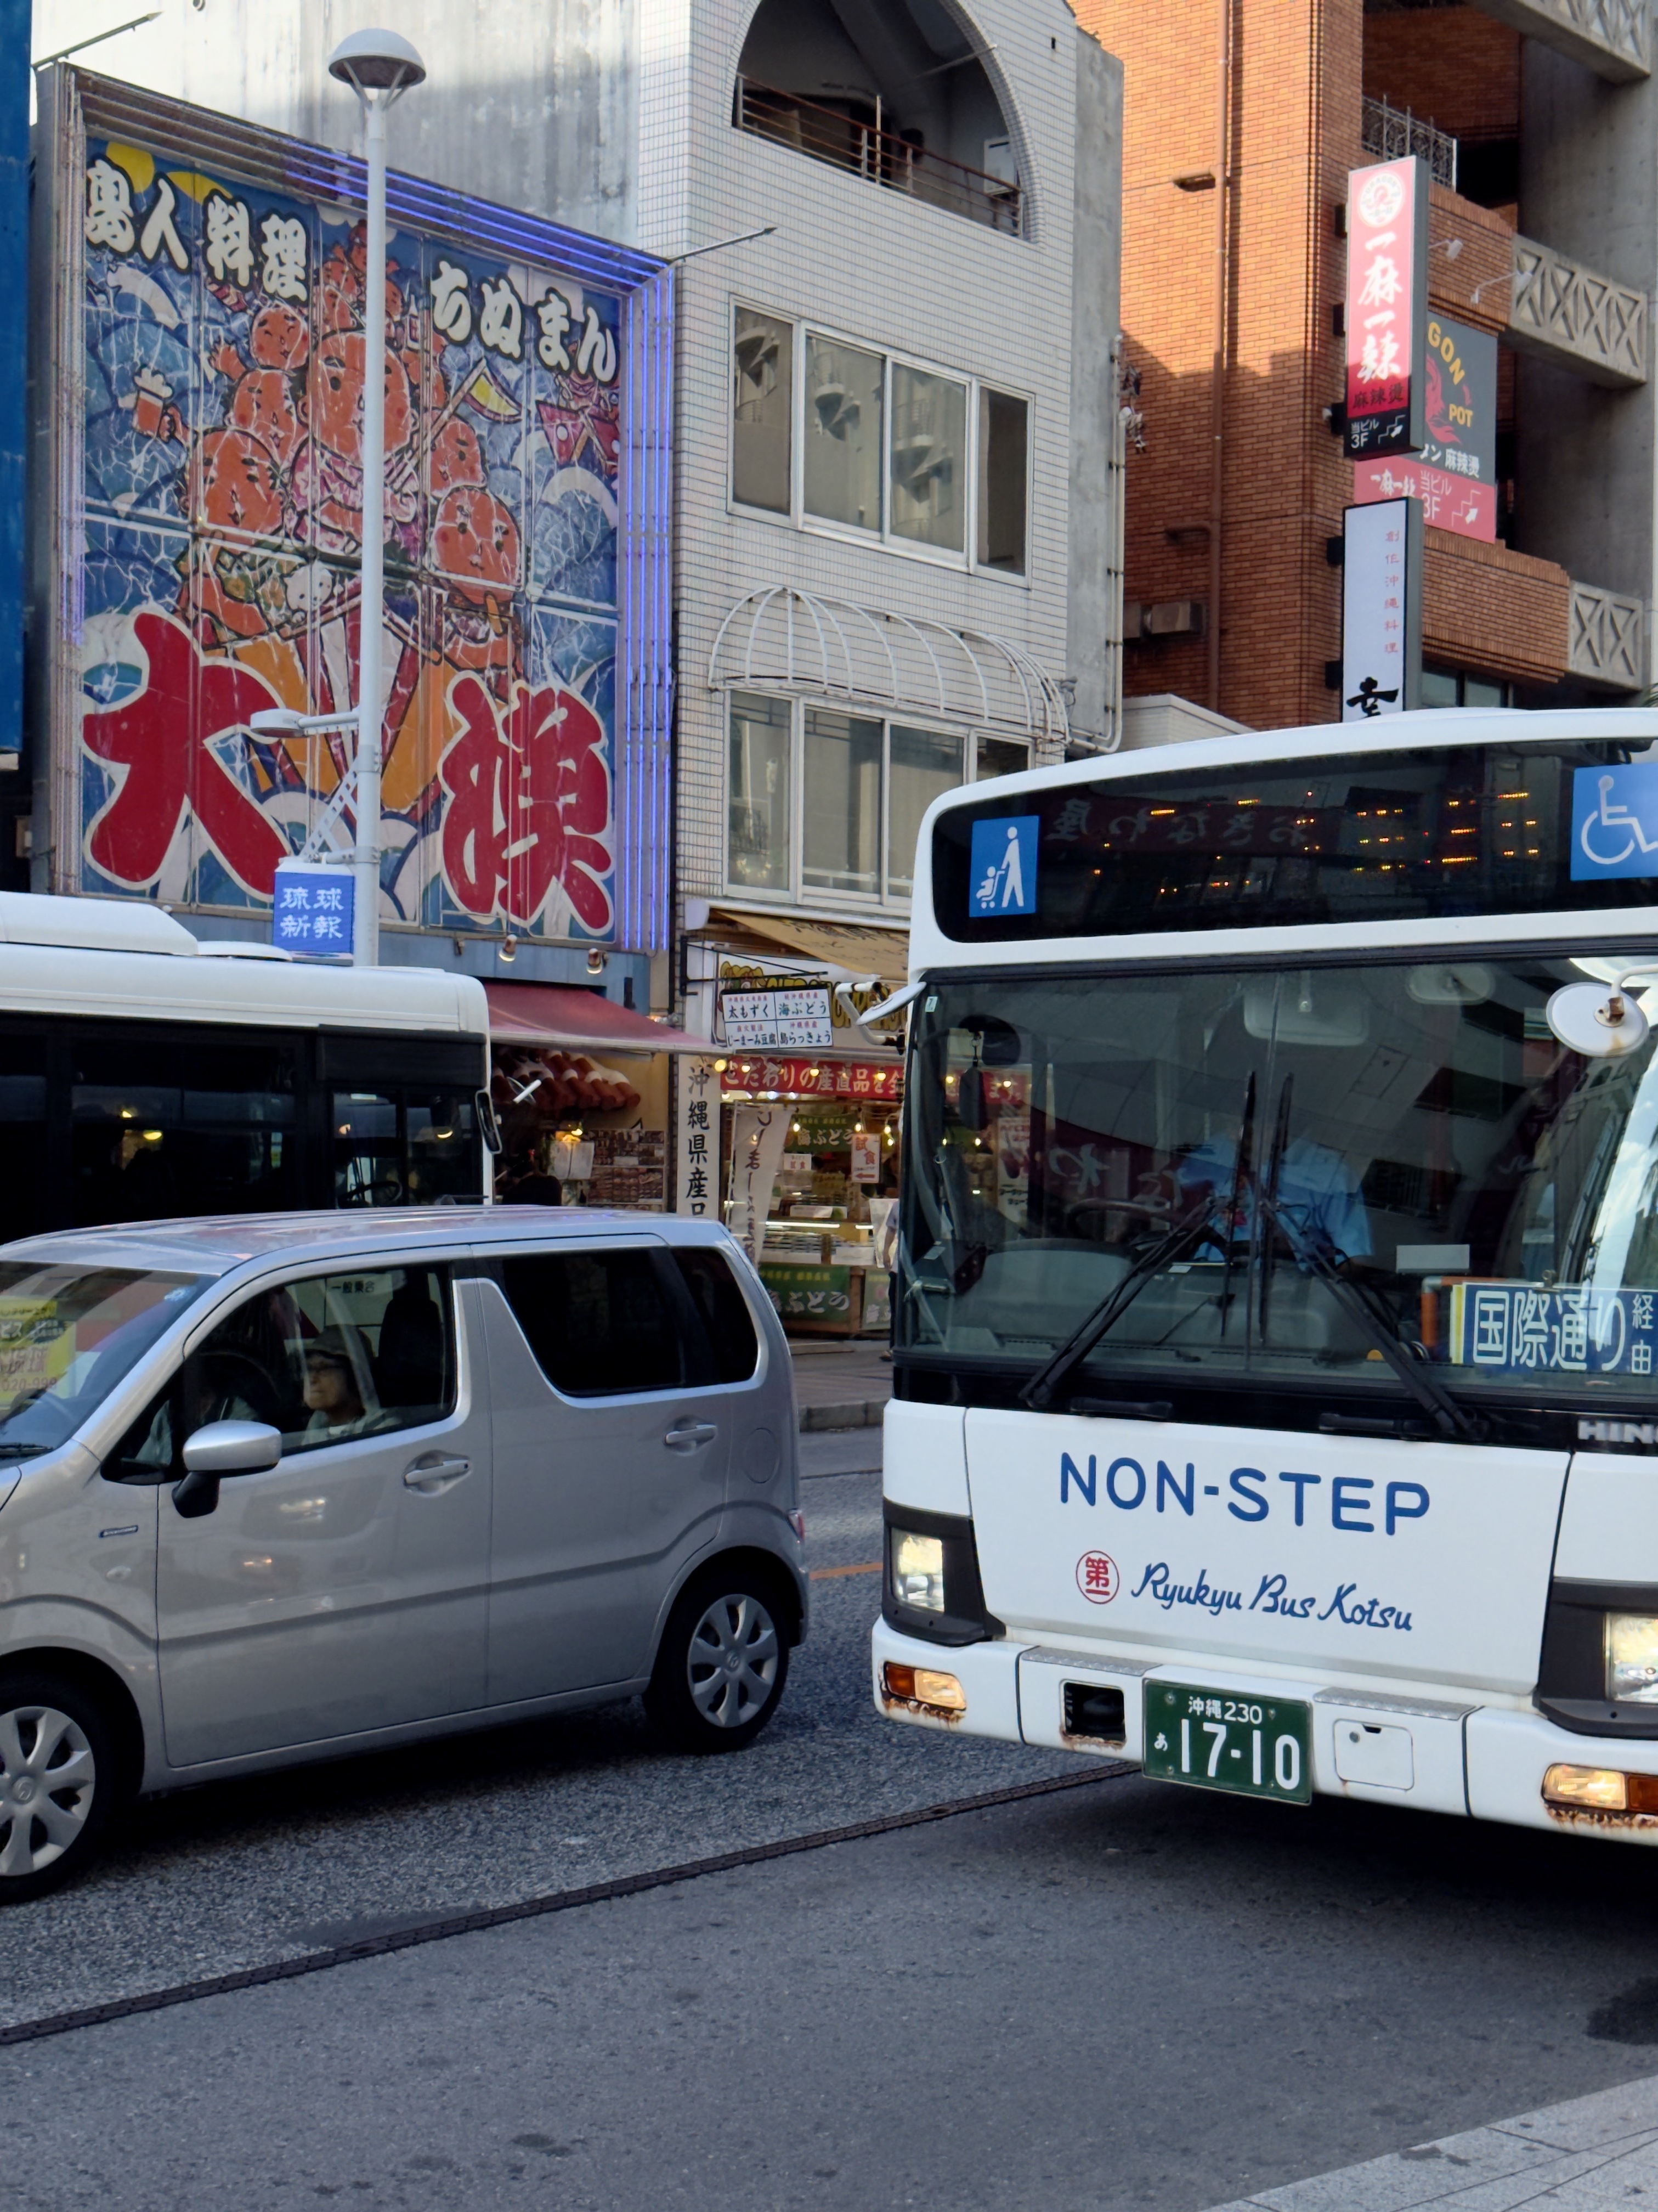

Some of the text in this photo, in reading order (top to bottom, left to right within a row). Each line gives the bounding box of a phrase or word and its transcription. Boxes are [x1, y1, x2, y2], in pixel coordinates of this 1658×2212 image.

[430, 260, 616, 383] ちぬまん
[1351, 417, 1379, 434] 当ビル
[1448, 403, 1473, 427] POT
[1351, 432, 1369, 449] 3F
[1419, 469, 1452, 496] 当ビル
[1422, 492, 1441, 521] 3F
[280, 887, 344, 911] 琉球
[280, 915, 343, 939] 新報
[728, 1003, 769, 1019] 太もずく
[779, 1001, 827, 1016] 海ぶどう
[728, 1032, 776, 1046] じーまーみ豆腐
[780, 1030, 831, 1045] 島らっきょう
[1473, 1289, 1625, 1371] 国際通り
[1631, 1294, 1653, 1374] 経由
[1578, 1420, 1658, 1444] HIN
[1060, 1452, 1430, 1536] NON-STEP
[1131, 1562, 1413, 1632] Ryukyu Bus Kotsu
[1154, 1732, 1168, 1752] あ
[1181, 1718, 1300, 1790] 17-10
